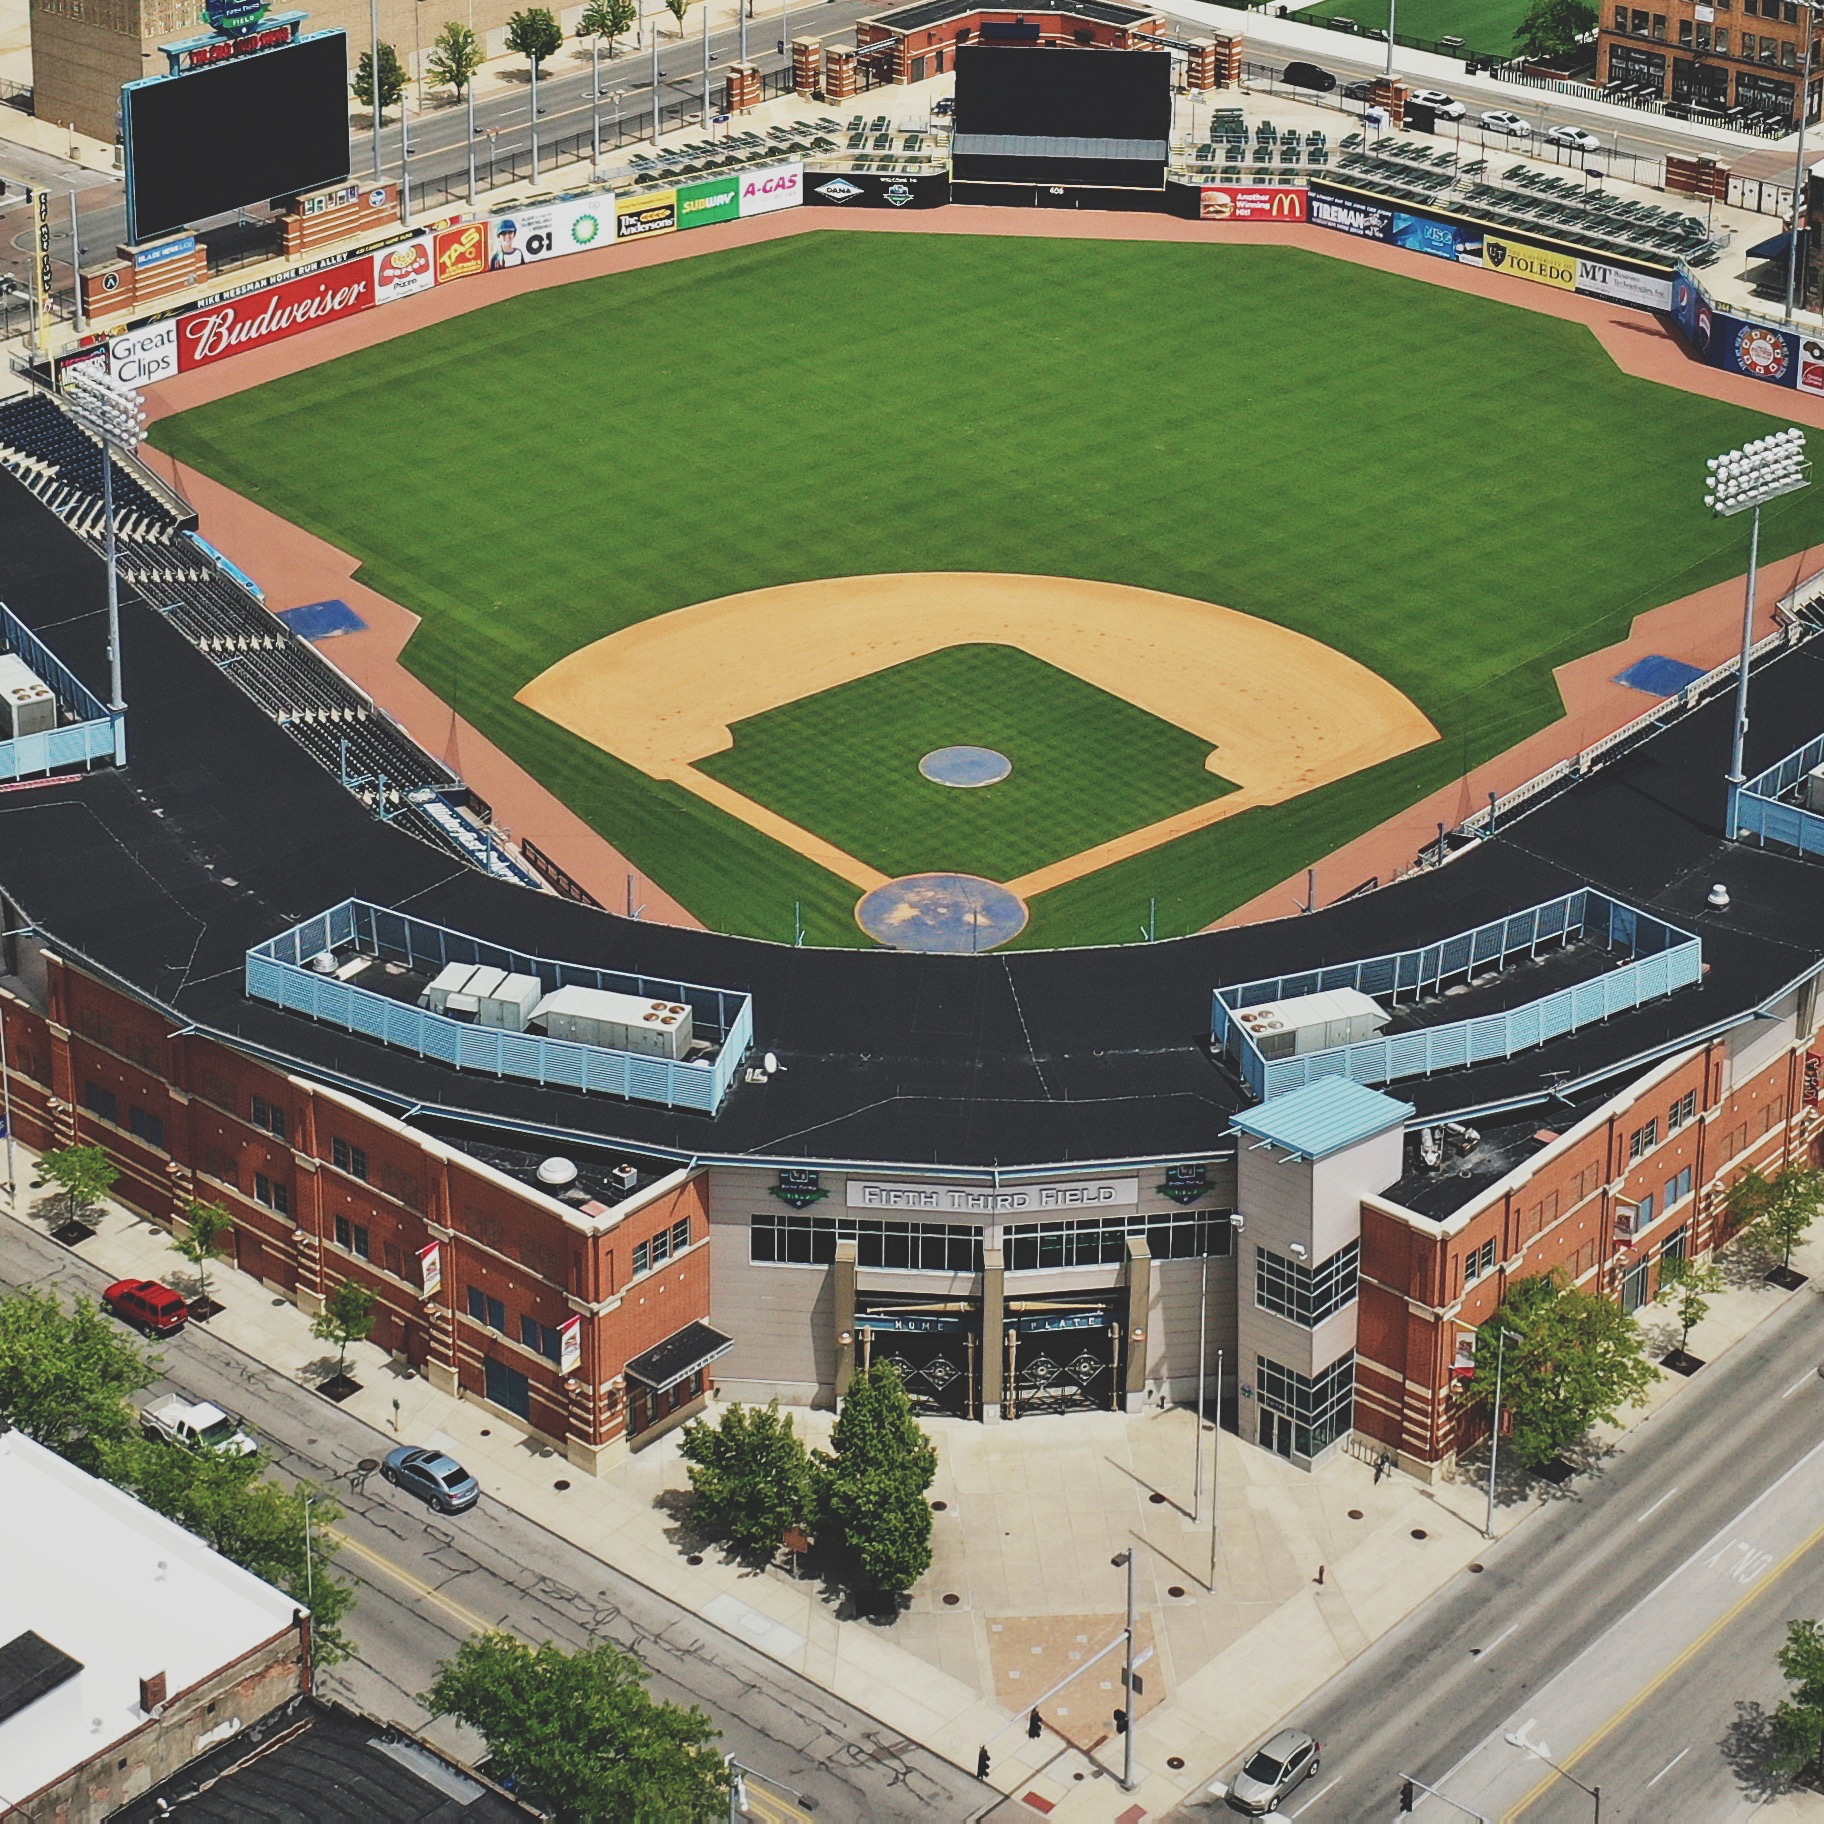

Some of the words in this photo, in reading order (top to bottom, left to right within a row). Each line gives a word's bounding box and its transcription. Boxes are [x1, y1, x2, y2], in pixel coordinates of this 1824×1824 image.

[232, 14, 255, 26] FIELD
[743, 173, 798, 197] A-GAS
[1236, 192, 1270, 202] Another
[683, 191, 736, 214] SUBWAY
[1236, 201, 1271, 211] Winning
[1311, 201, 1364, 227] TIREMAN
[619, 213, 639, 226] The
[619, 216, 675, 237] Andersons
[439, 226, 481, 267] TAS
[197, 294, 221, 308] MIKE
[298, 262, 318, 274] RUN
[319, 252, 348, 269] ALLEY
[1507, 254, 1573, 283] TOLEDO
[1579, 261, 1611, 284] MT
[185, 280, 366, 361] Budweiser
[111, 328, 175, 361] Great
[118, 353, 171, 383] Clips
[862, 1185, 939, 1207] FIFTH
[948, 1189, 1031, 1211] THIRD
[1040, 1186, 1118, 1207] FIELD
[895, 1319, 945, 1331] HOME
[1031, 1317, 1095, 1331] PLATE
